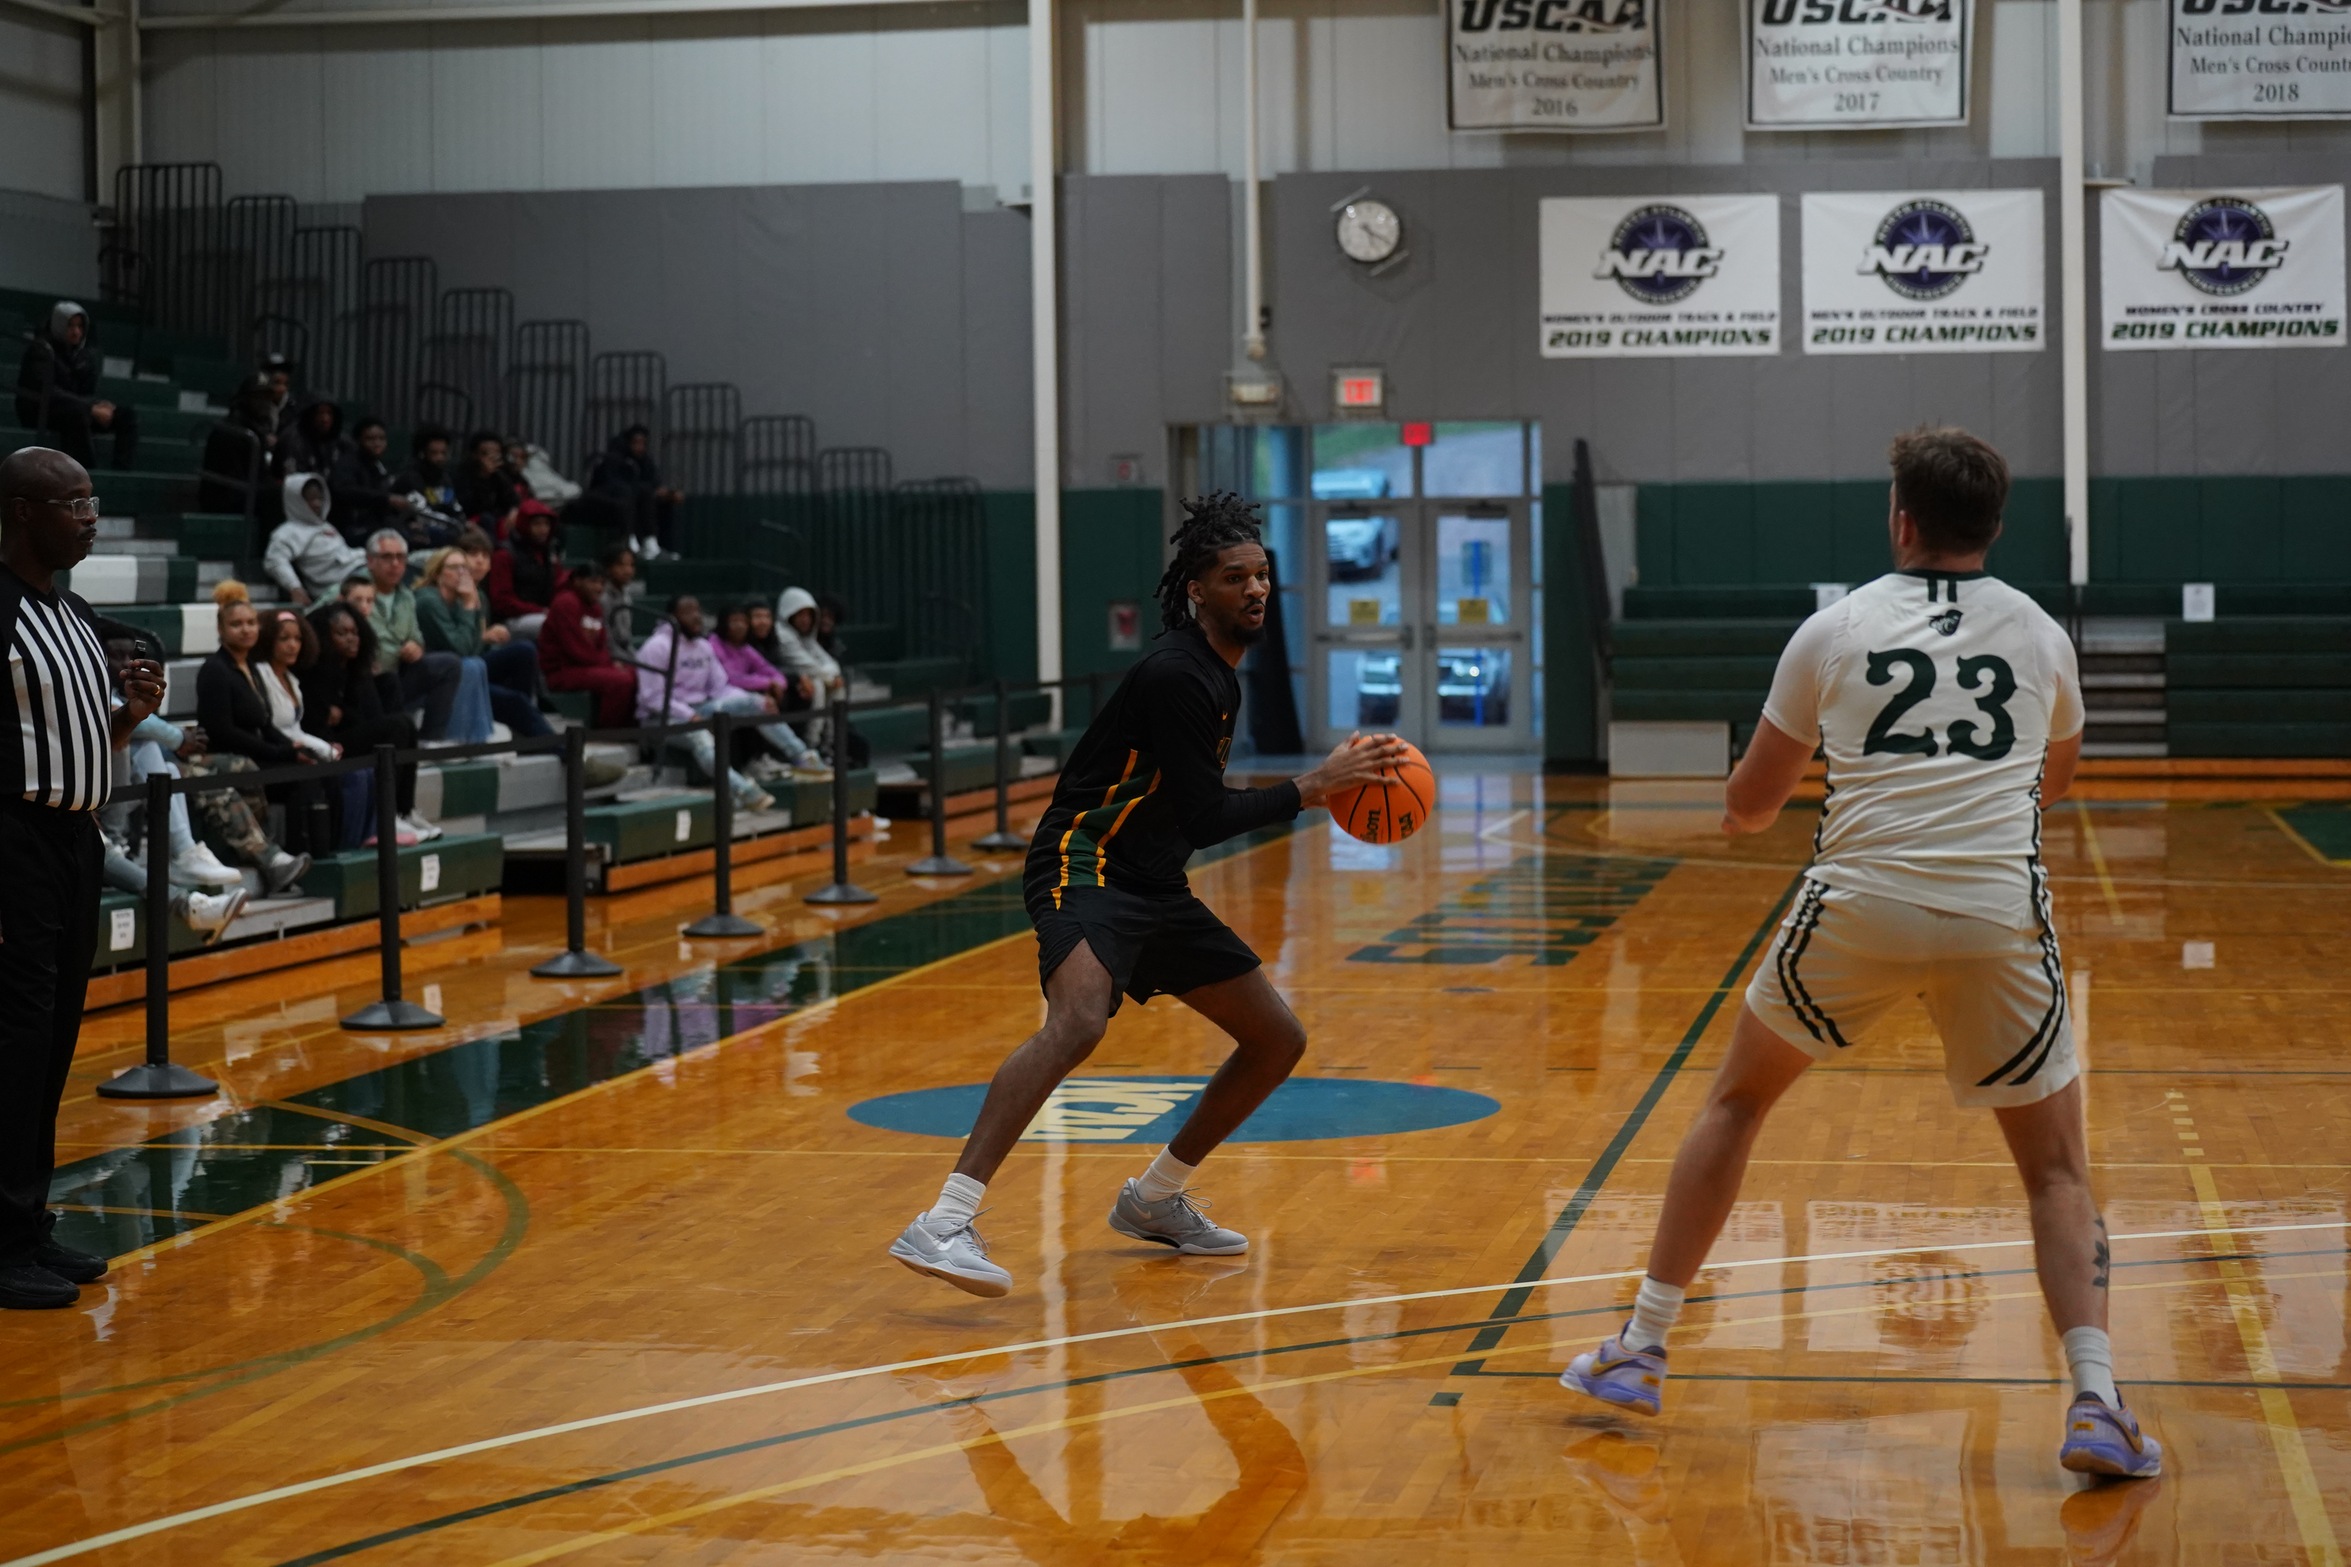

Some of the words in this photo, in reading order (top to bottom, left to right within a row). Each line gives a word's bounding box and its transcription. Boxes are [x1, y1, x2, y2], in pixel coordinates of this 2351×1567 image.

[1755, 35, 1840, 57] National
[1847, 33, 1959, 59] Champions
[2177, 25, 2260, 47] National
[2268, 24, 2351, 51] Champi
[1456, 43, 1538, 62] National
[1543, 42, 1655, 68] Champions
[2190, 56, 2240, 74] Men's
[2246, 56, 2290, 74] Cross
[2296, 55, 2351, 74] Count
[1522, 71, 1569, 88] Cross
[1571, 73, 1639, 91] Country
[1769, 66, 1819, 84] Men's
[1824, 66, 1870, 83] Cross
[1875, 66, 1944, 87] Country
[2253, 83, 2300, 101] 2018
[1531, 98, 1579, 117] 2016
[1833, 93, 1881, 112] 2017
[1594, 247, 1725, 279] NAC
[1856, 242, 1990, 275] NAC
[2157, 239, 2290, 271] NAC
[2255, 303, 2324, 315] COUNTRY
[1548, 330, 1612, 348] 2019
[1620, 328, 1771, 347] CHAMPIONS
[1811, 327, 1875, 344] 2019
[1885, 324, 2038, 343] CHAMPIONS
[2112, 322, 2176, 340] 2019
[2186, 320, 2338, 338] CHAMPIONS
[1863, 647, 2018, 761] 23
